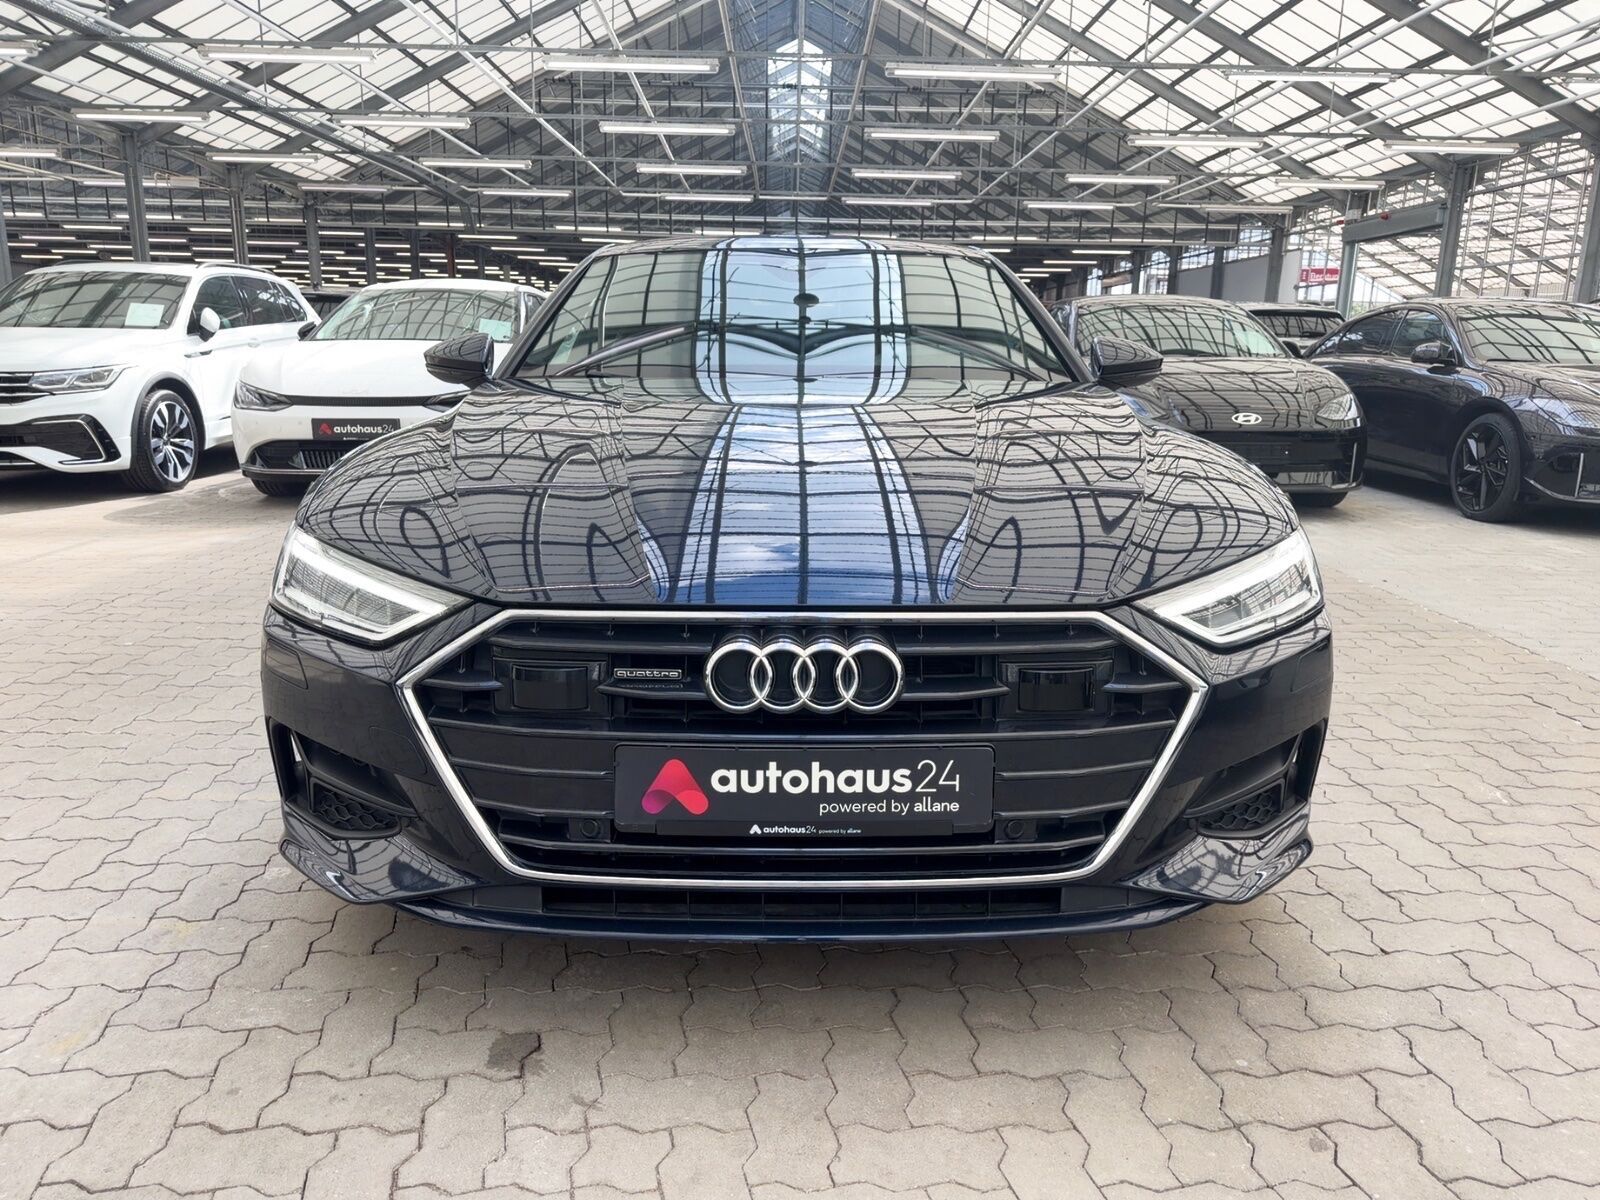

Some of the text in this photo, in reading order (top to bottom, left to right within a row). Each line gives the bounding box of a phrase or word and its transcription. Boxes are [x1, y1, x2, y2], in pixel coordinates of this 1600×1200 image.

[333, 424, 394, 434] autohaus24
[616, 670, 679, 678] quattro
[710, 759, 960, 794] autohaus24
[819, 796, 960, 816] powered by allane
[763, 825, 816, 834] autohaus24
